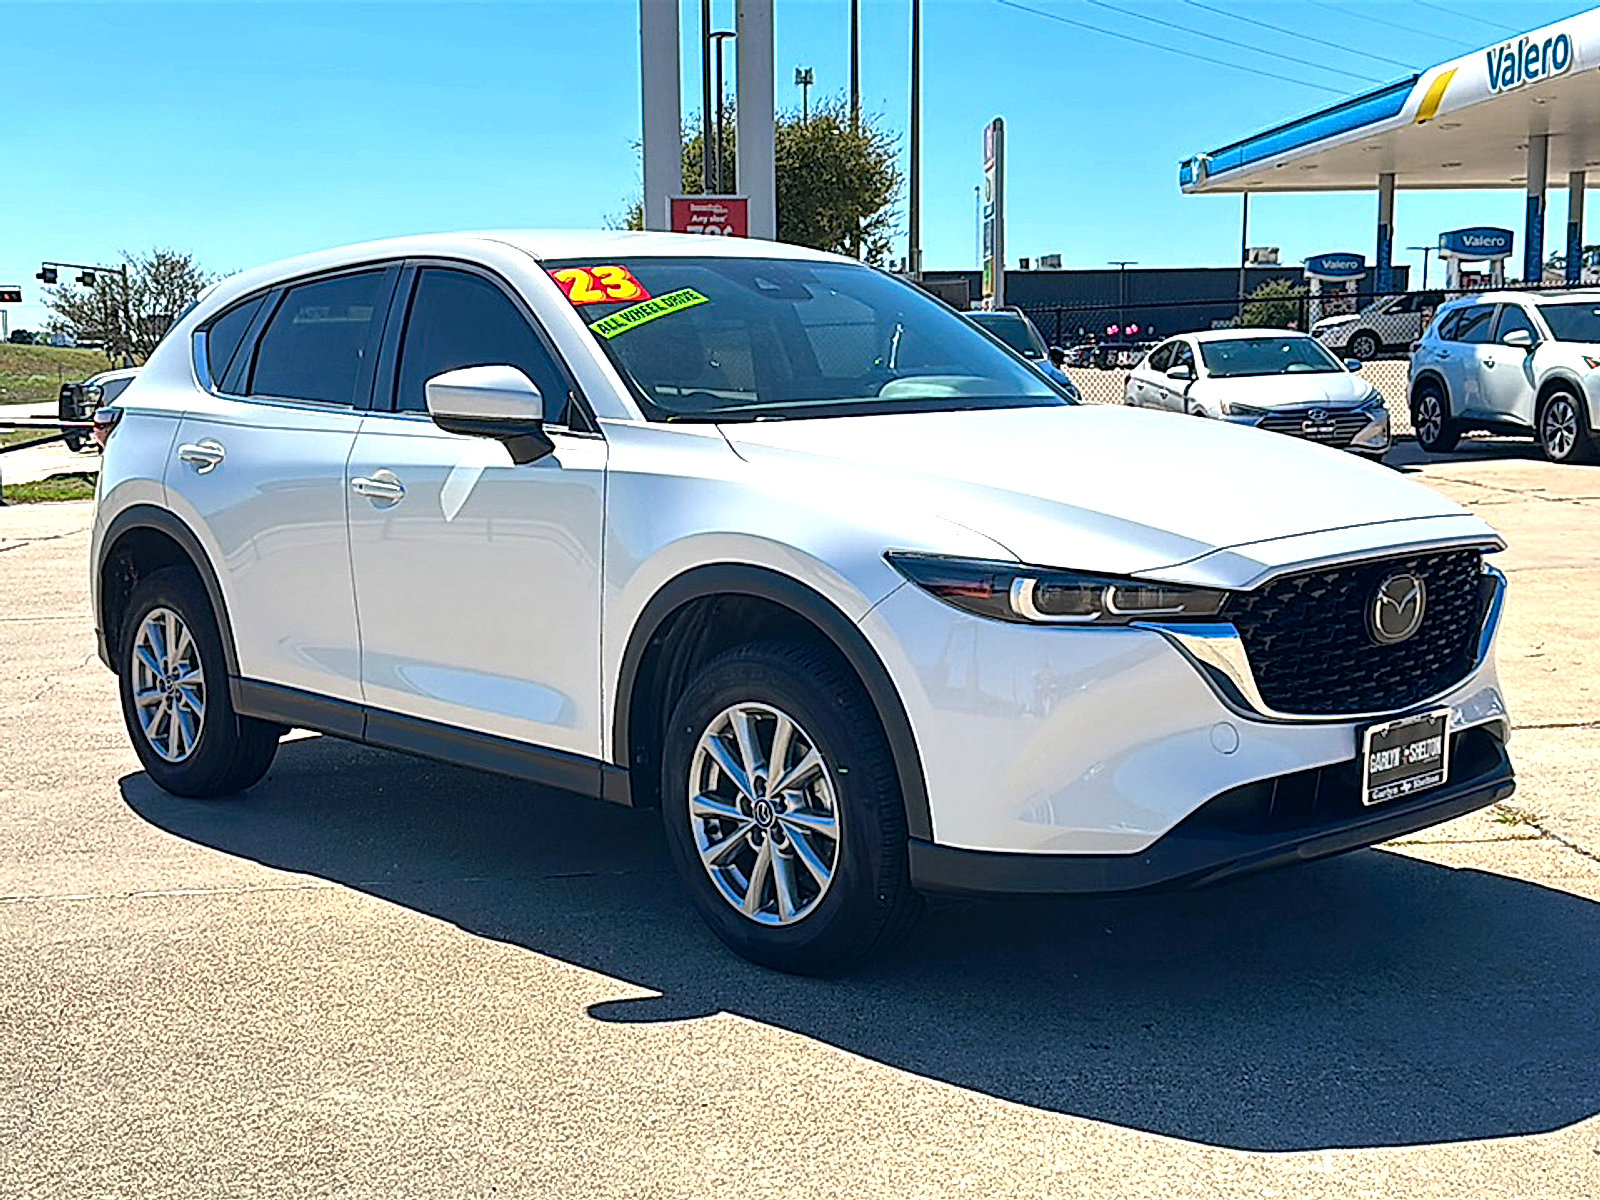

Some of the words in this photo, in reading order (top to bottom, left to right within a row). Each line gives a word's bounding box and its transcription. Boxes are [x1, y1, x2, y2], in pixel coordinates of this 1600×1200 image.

[1486, 33, 1569, 90] Valero
[1462, 235, 1505, 247] Valero
[1322, 259, 1359, 270] Valero
[554, 265, 641, 302] 23
[597, 316, 628, 335] ALL
[619, 301, 669, 324] WHEEL
